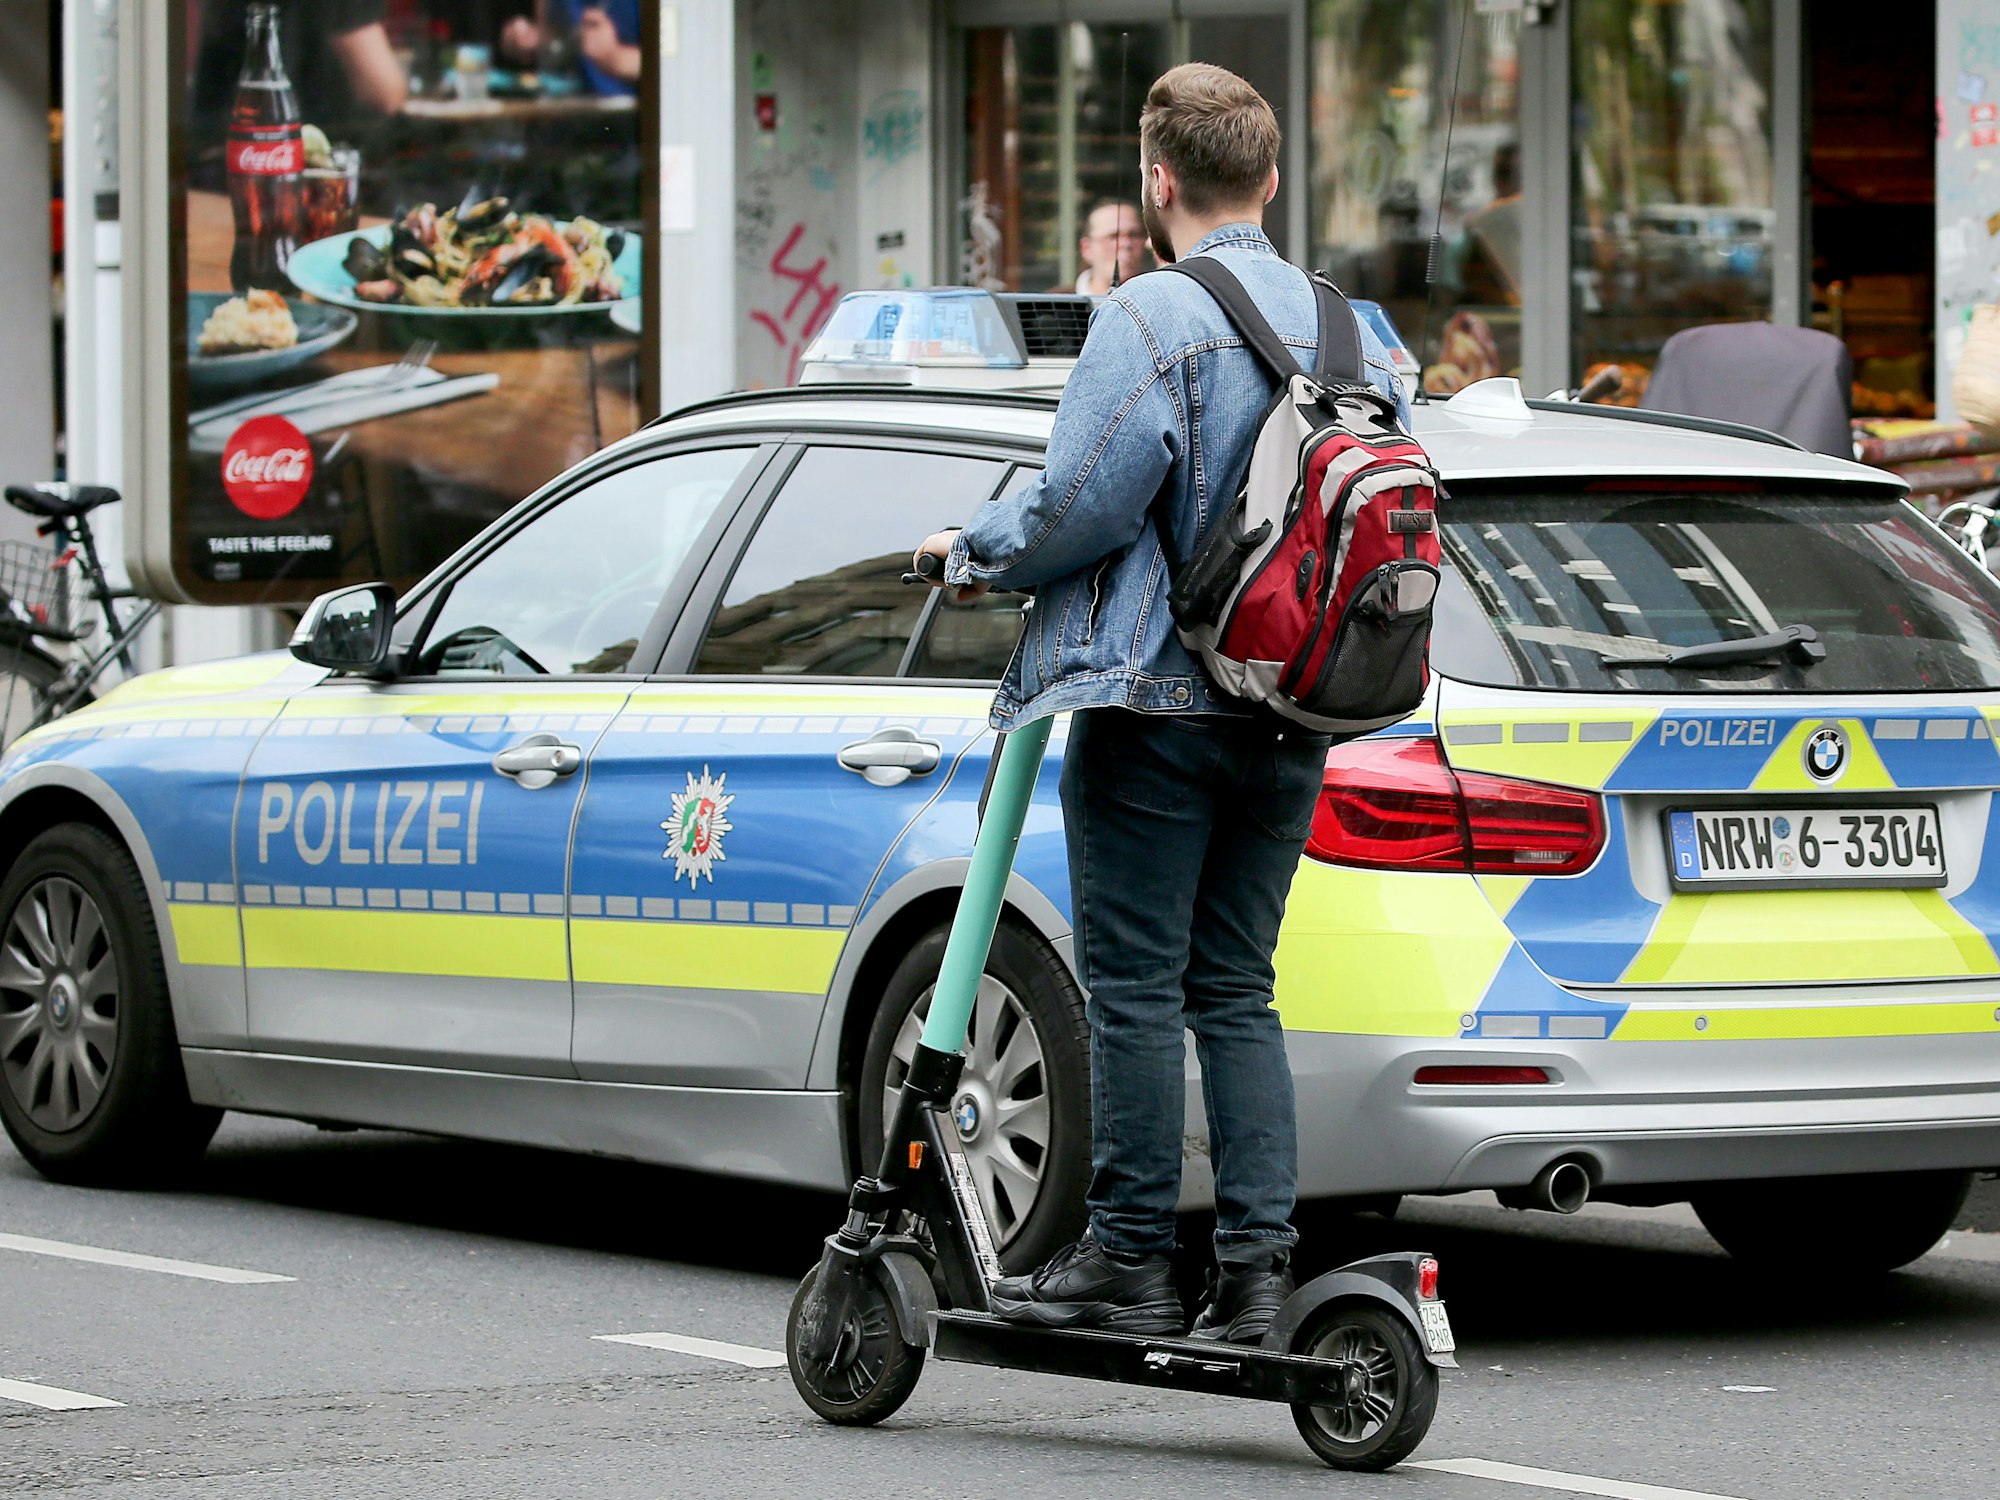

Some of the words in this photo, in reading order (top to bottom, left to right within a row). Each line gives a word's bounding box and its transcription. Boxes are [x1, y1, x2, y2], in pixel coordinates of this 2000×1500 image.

[225, 448, 308, 484] Coca-Cola
[209, 536, 248, 553] TASTE
[250, 536, 276, 552] THE
[278, 534, 332, 551] FEELING
[1659, 718, 1776, 747] POLIZEI
[258, 780, 485, 865] POLIZEI
[1681, 851, 1693, 868] D
[1697, 816, 1774, 870] NRW
[1799, 814, 1938, 869] 6-3304
[1422, 1305, 1446, 1326] 754
[1428, 1327, 1453, 1348] PNR
